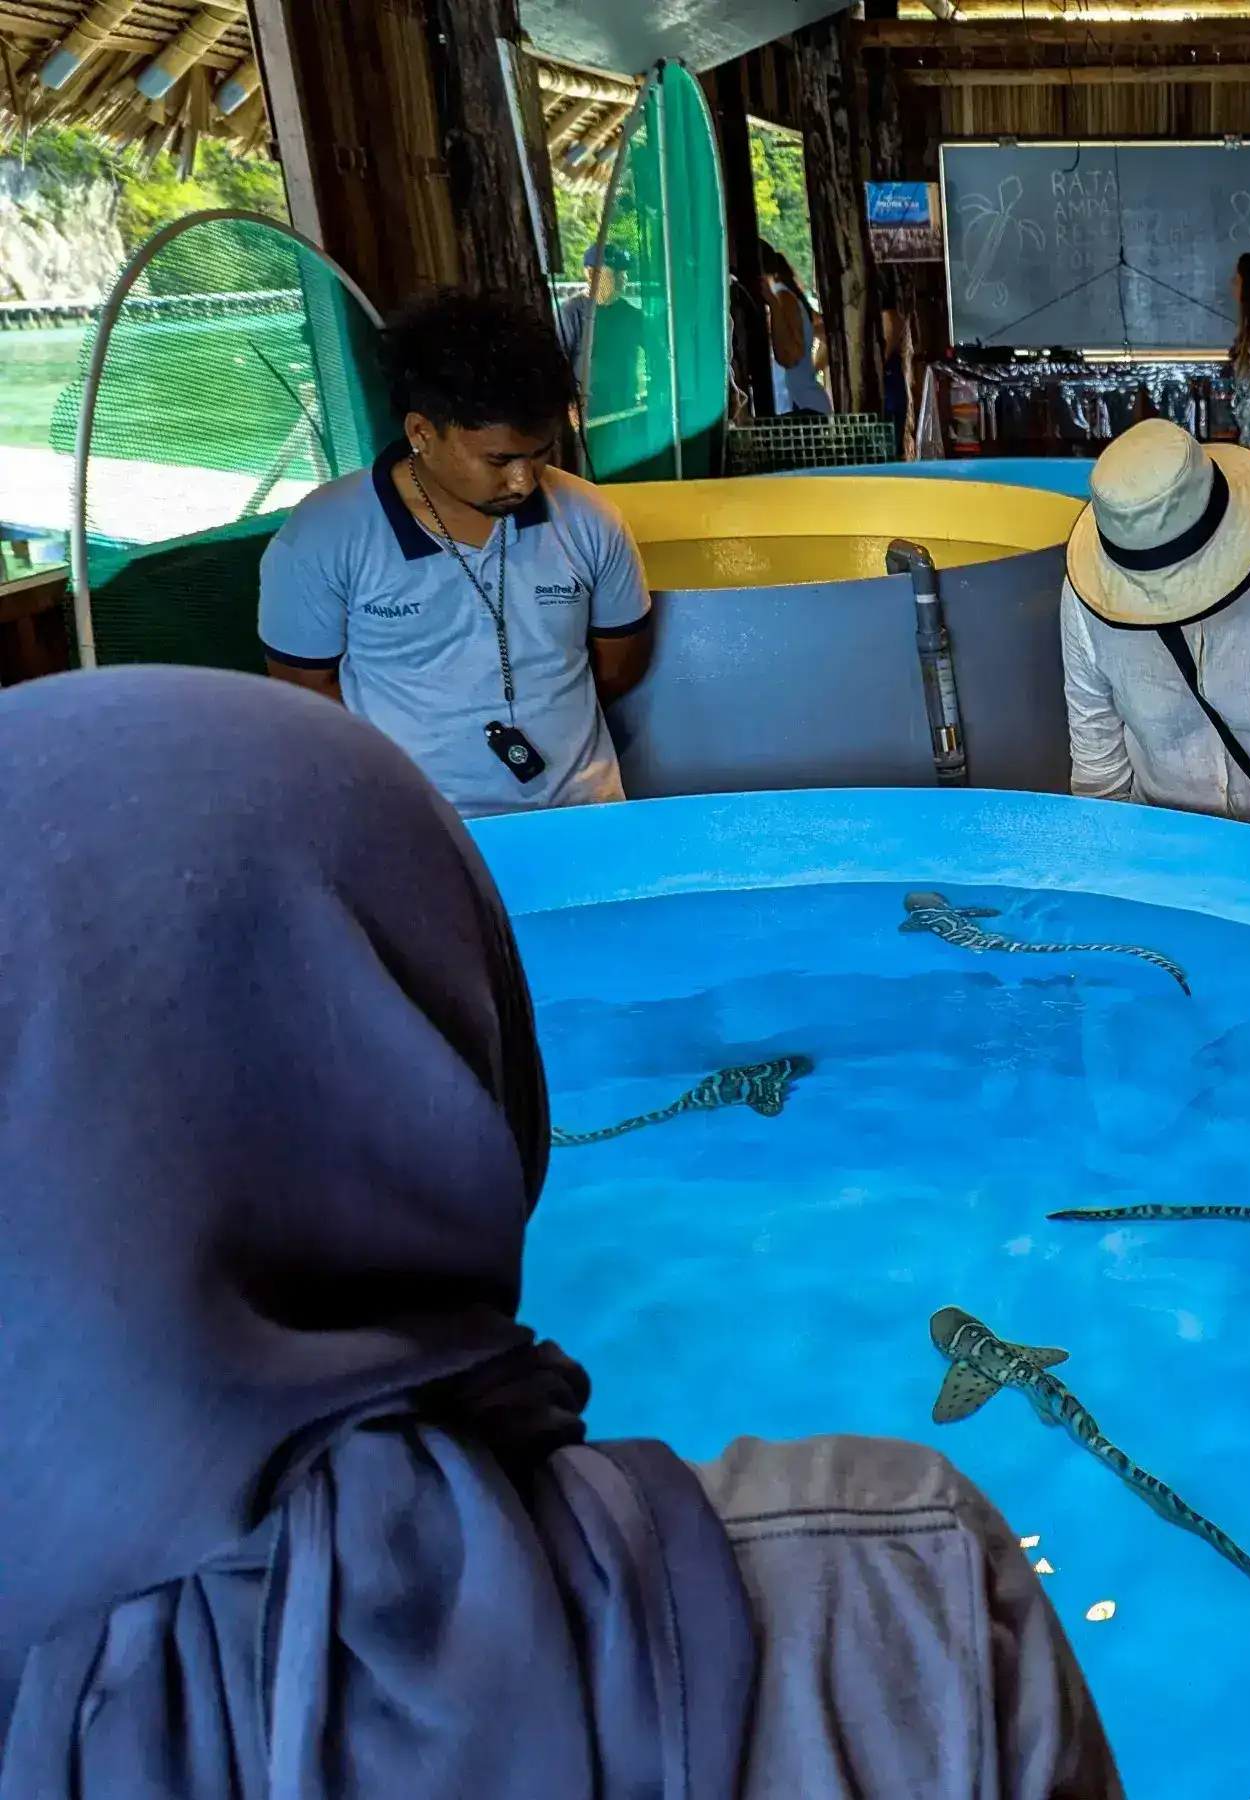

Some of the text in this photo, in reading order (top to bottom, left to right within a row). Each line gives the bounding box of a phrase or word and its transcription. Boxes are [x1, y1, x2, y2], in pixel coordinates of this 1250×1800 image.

[1051, 169, 1117, 196] RAJA
[535, 583, 572, 594] SeaTrek
[363, 602, 422, 618] RAHMAT
